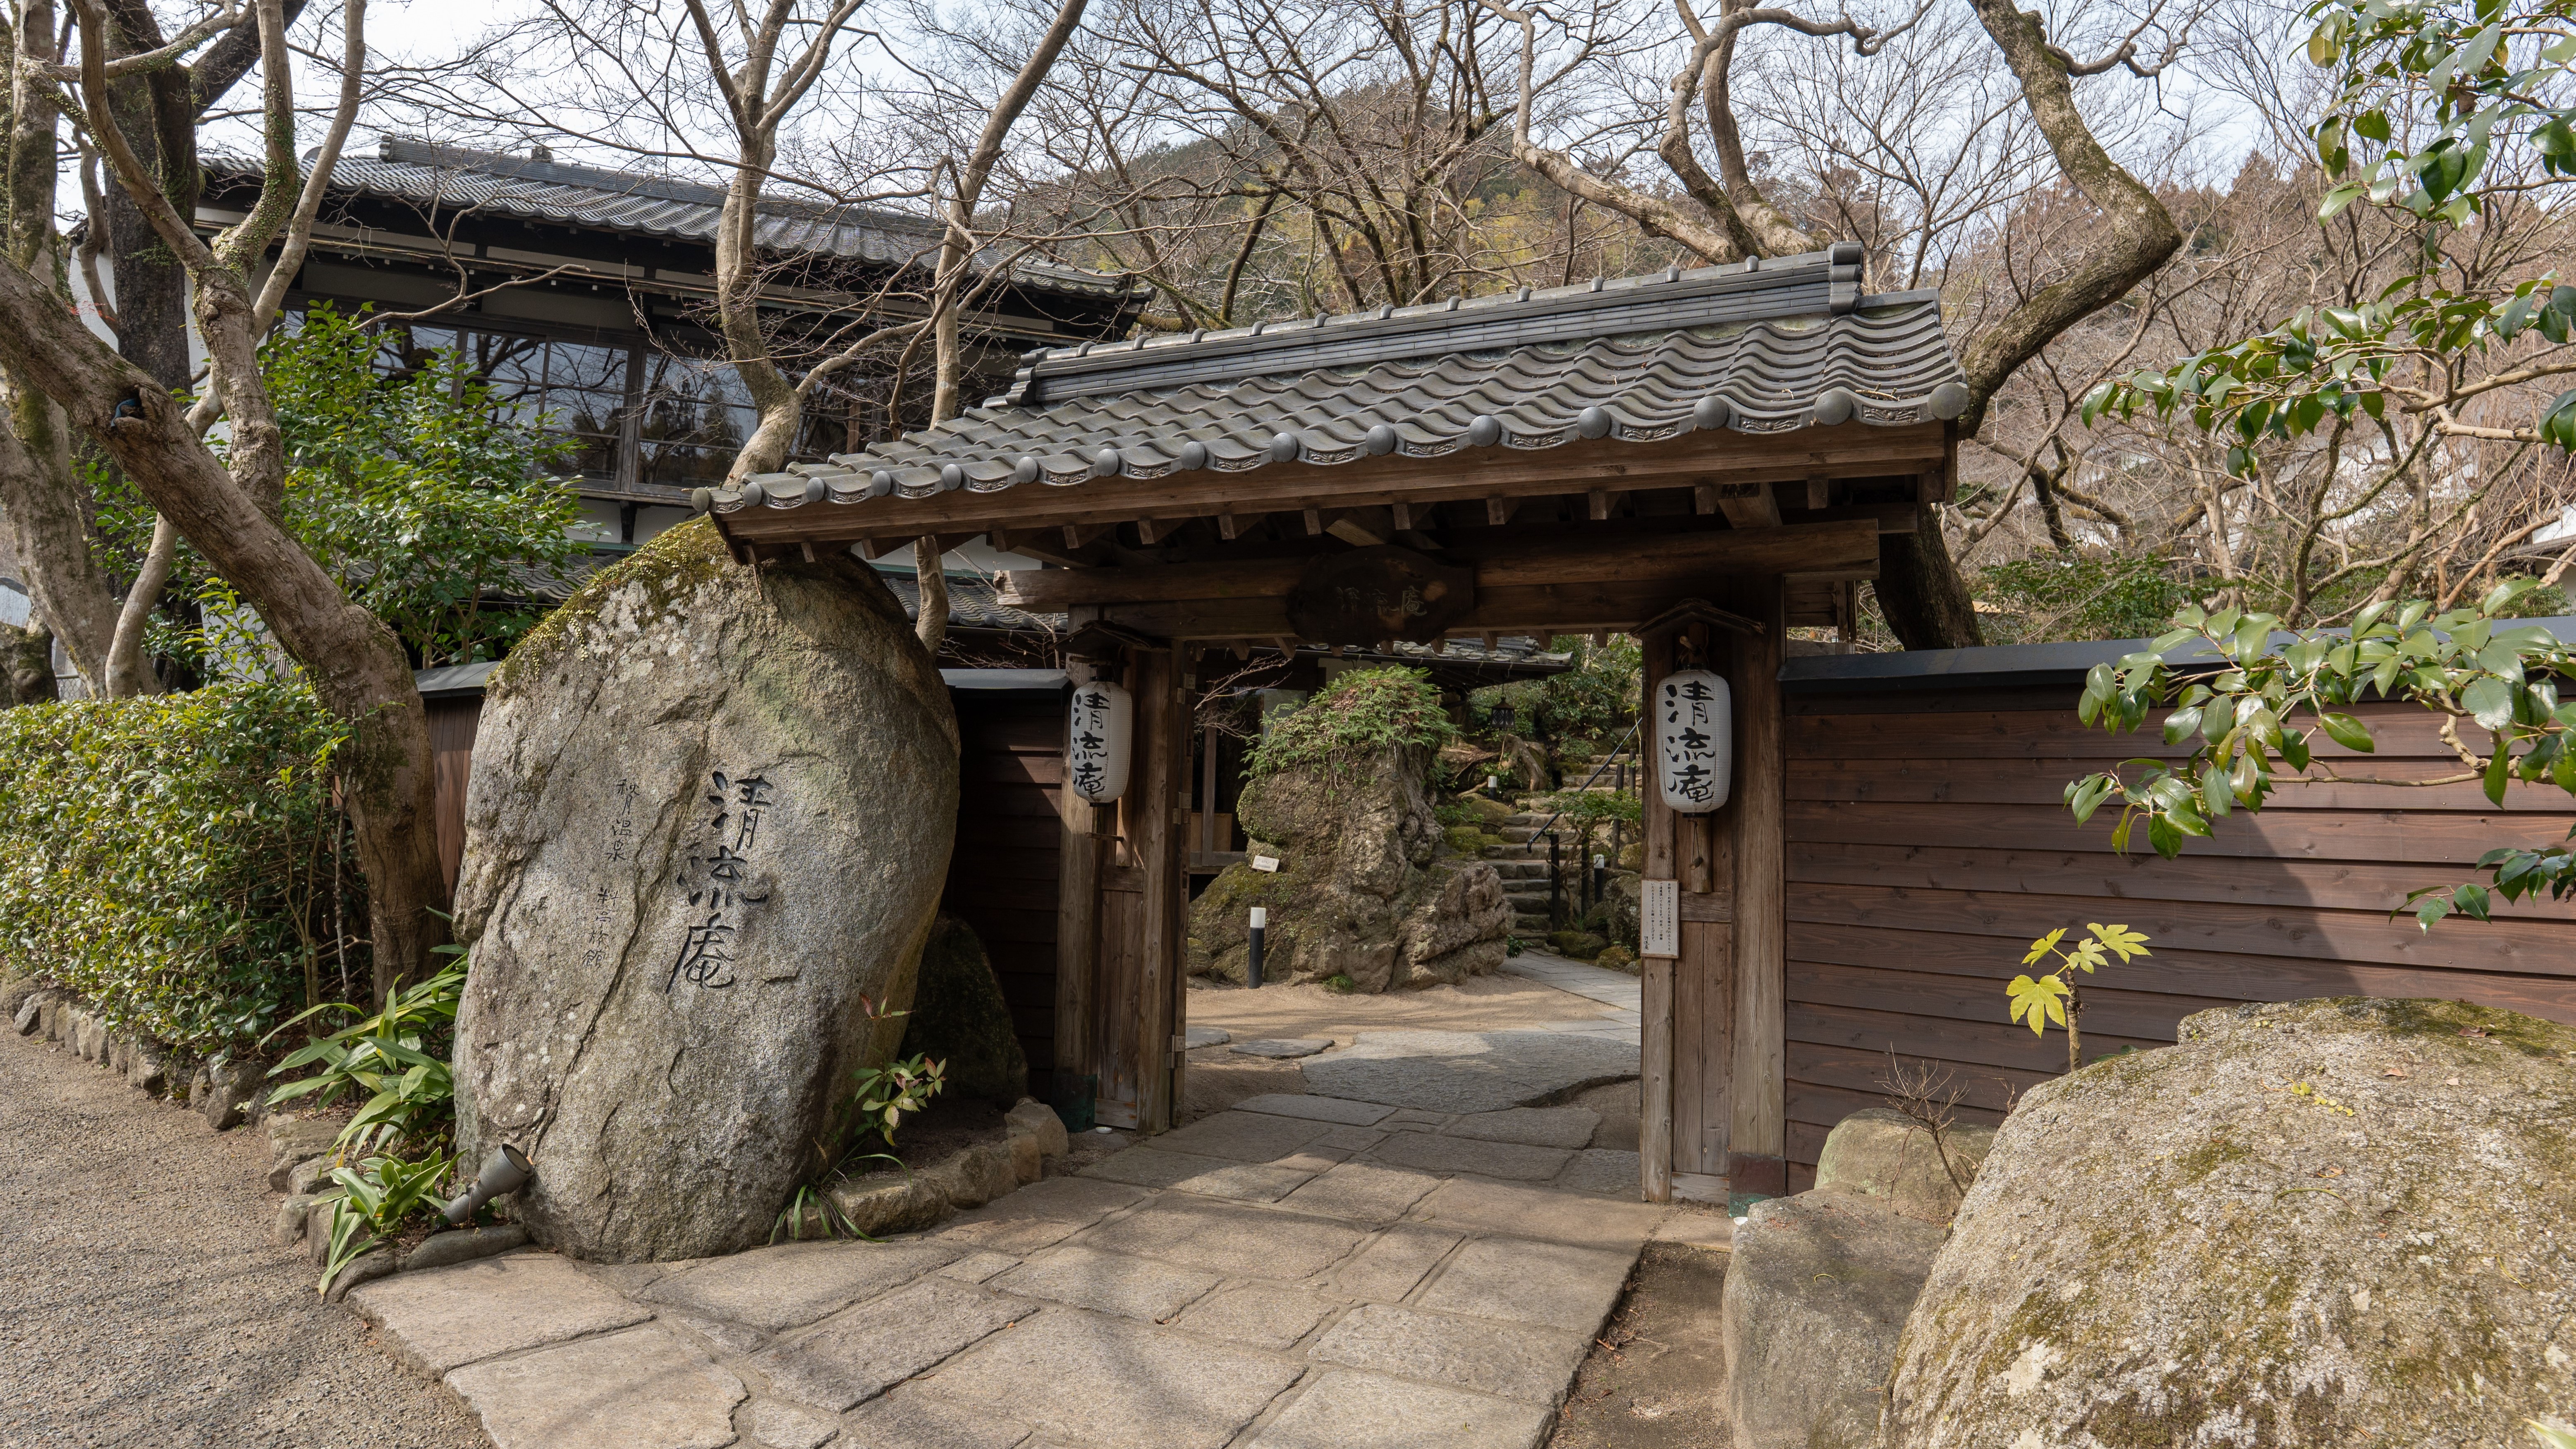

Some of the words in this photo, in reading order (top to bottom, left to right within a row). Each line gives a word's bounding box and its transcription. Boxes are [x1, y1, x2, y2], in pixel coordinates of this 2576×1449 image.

[1072, 692, 1110, 795] 清流庵
[1665, 680, 1715, 803] 清流庵
[605, 778, 640, 861] 秋月温泉
[582, 887, 619, 968] 料亭旅館
[665, 771, 773, 994] 清流庵
